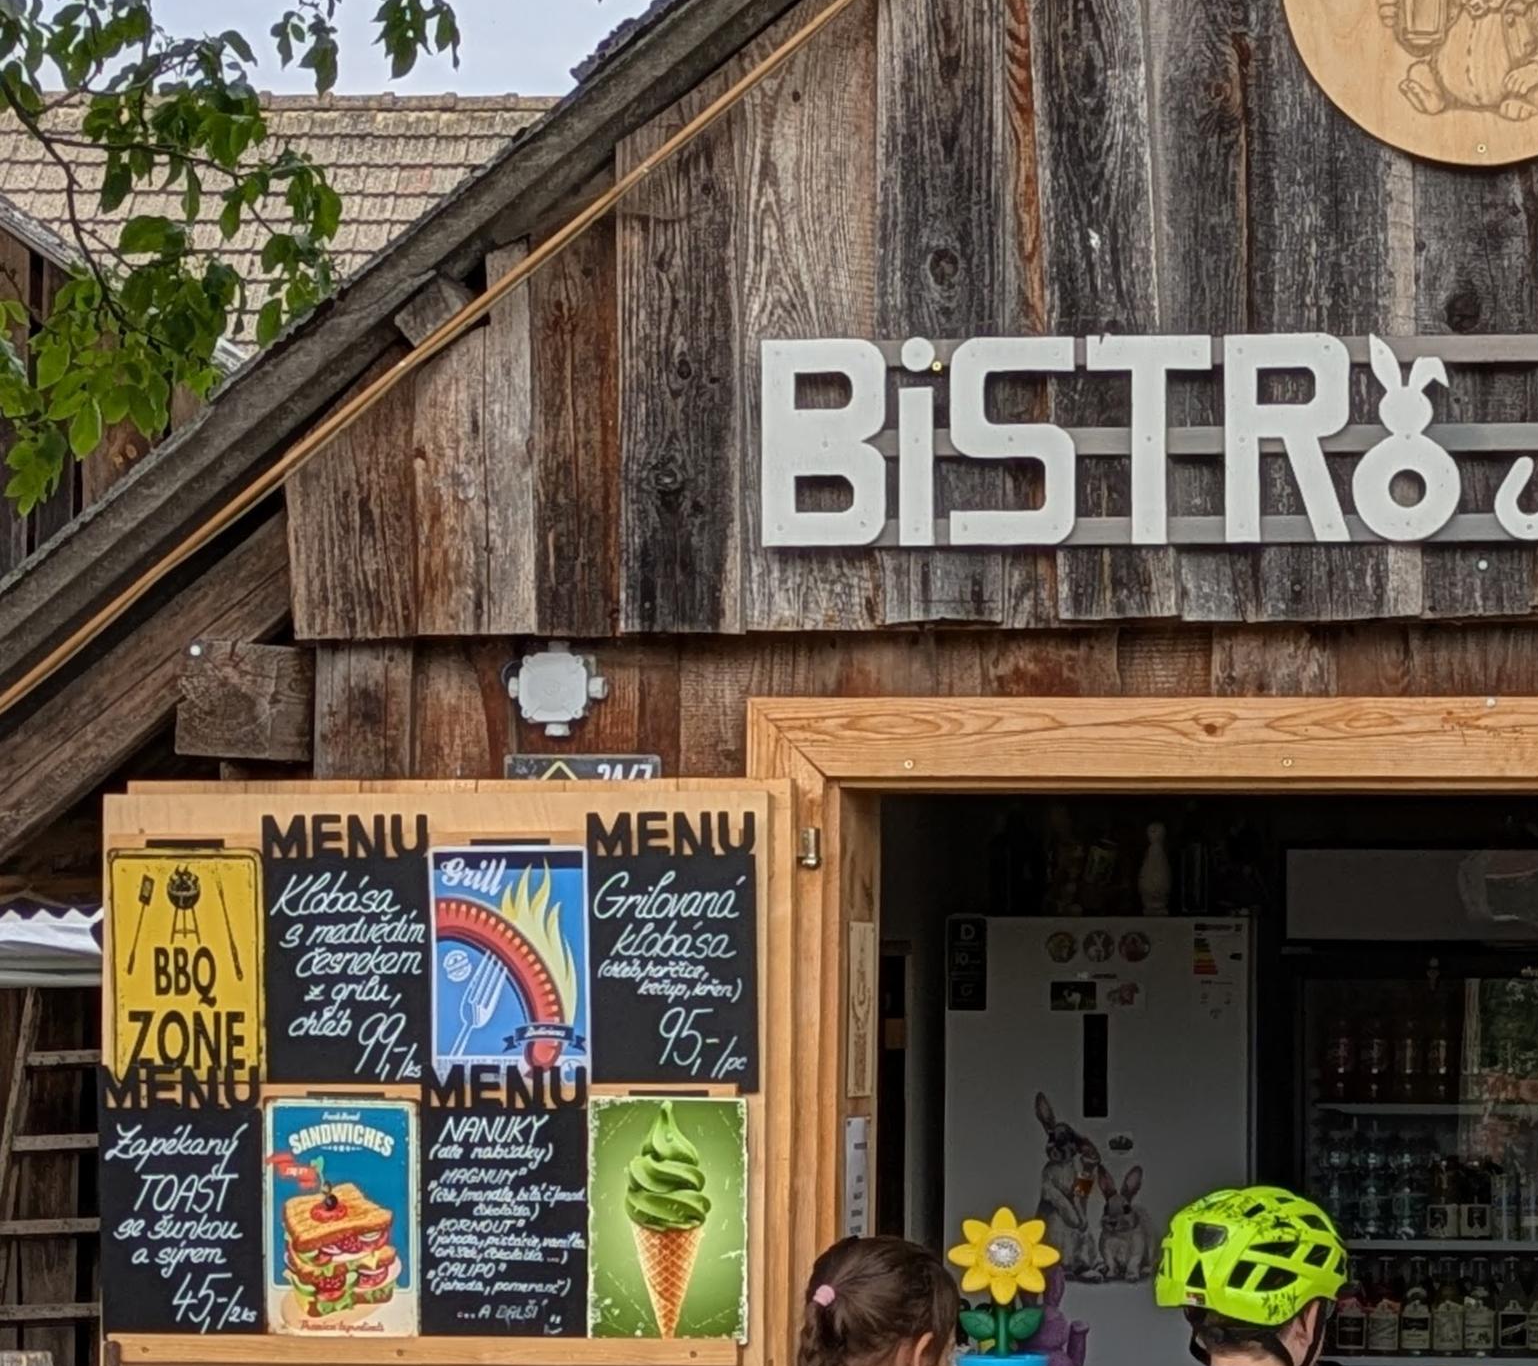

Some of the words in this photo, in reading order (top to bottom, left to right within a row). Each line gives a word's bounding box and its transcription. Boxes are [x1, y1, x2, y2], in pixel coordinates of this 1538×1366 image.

[262, 814, 428, 859] MENU
[586, 811, 756, 856] MENU
[270, 870, 402, 916] Klobása
[440, 857, 507, 897] Grill
[593, 871, 746, 919] Grilovaná
[279, 924, 304, 948] s
[305, 910, 425, 946] medvědím
[610, 920, 737, 959] klobása
[154, 947, 217, 1008] BBQ
[295, 946, 423, 978] česnekem
[304, 984, 326, 1002] z
[331, 975, 403, 1017] grilu,
[128, 1010, 246, 1070] ZONE
[288, 1008, 352, 1037] chléb
[93, 1065, 260, 1109] MENU
[422, 1064, 587, 1109] MENU
[289, 1122, 395, 1157] SANDWICHES
[438, 1114, 550, 1143] NANUKY
[105, 1122, 249, 1180] Zapékaný
[133, 1173, 239, 1213] TOAST
[113, 1218, 145, 1240] se
[147, 1213, 243, 1240] šunkou
[131, 1247, 149, 1264] a
[155, 1240, 227, 1278] sýrem
